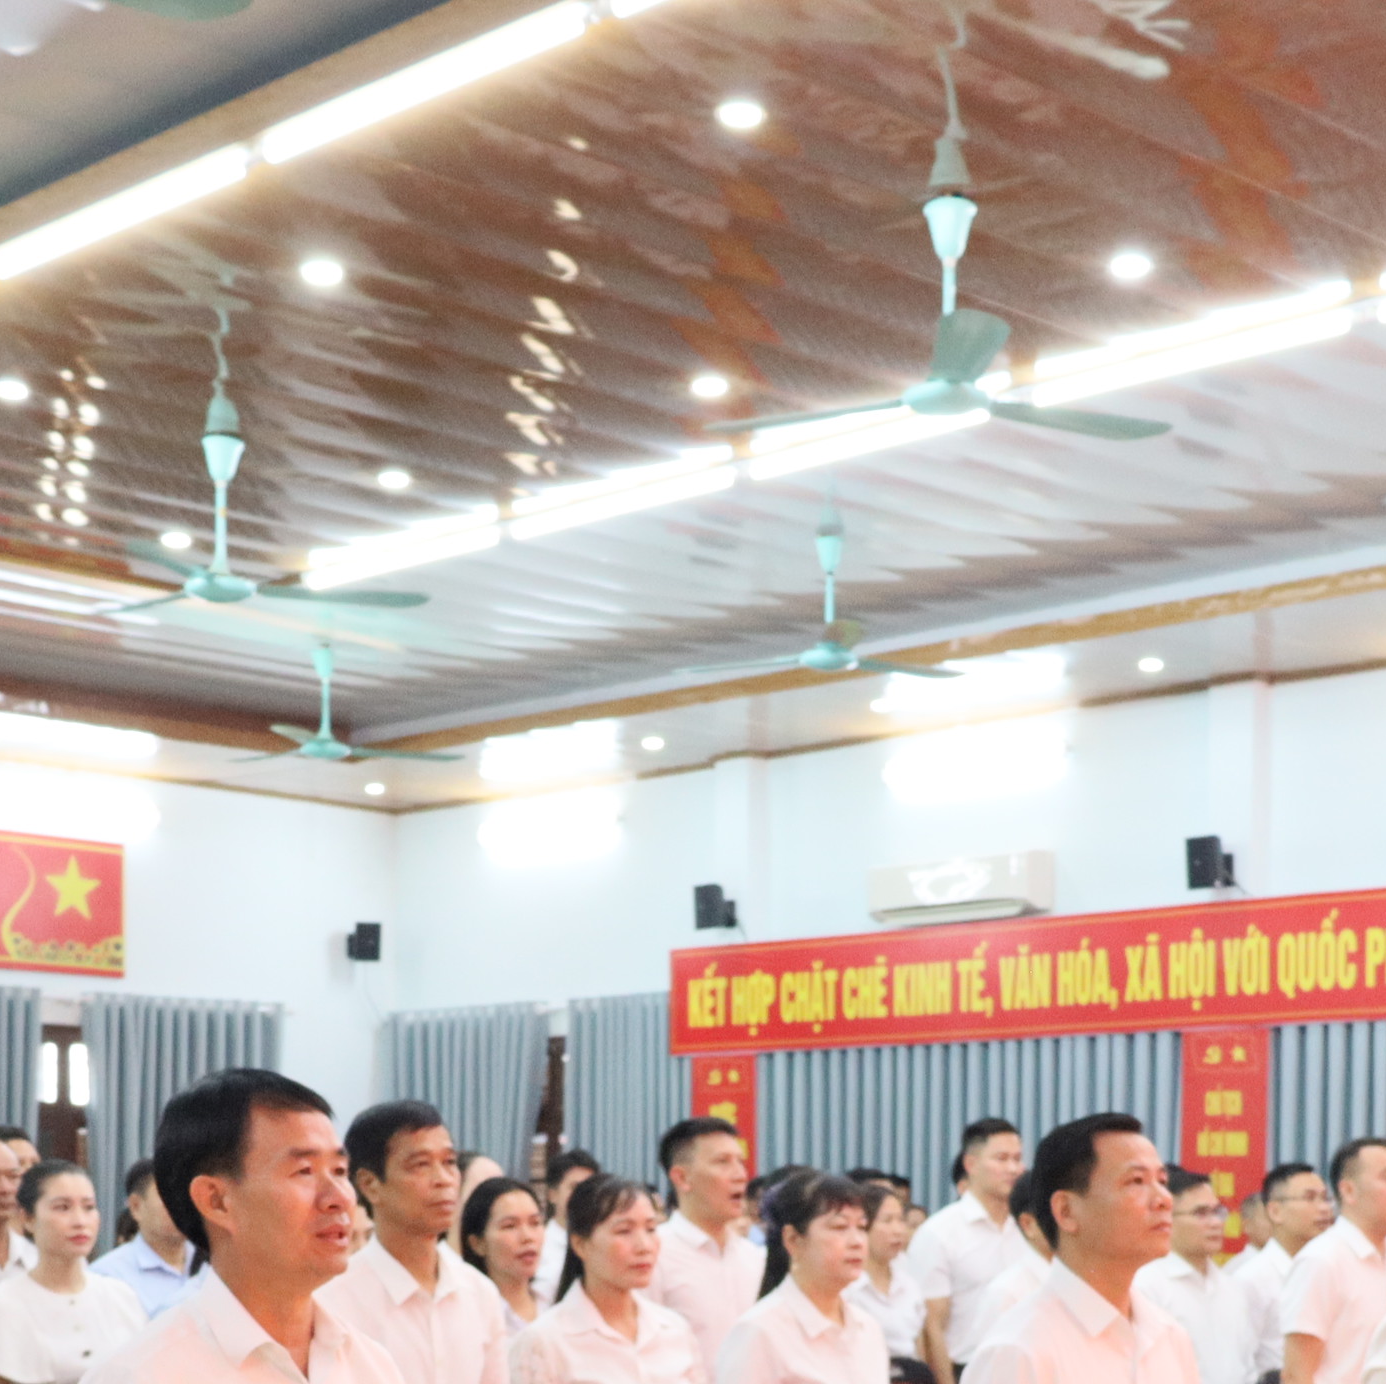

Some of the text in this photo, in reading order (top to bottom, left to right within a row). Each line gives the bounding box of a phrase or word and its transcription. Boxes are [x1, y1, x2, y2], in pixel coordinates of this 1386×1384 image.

[687, 962, 728, 1028] KẾT
[731, 969, 776, 1036] HỢP
[780, 960, 838, 1033] CHẶT
[893, 961, 952, 1017] KINH
[957, 940, 994, 1018] TẾ,
[999, 944, 1052, 1011] VĂN
[1057, 937, 1118, 1011] HÓA,
[1168, 927, 1216, 1011] HỘI
[1222, 923, 1270, 996] VỚI
[1277, 907, 1358, 999] QUỐC
